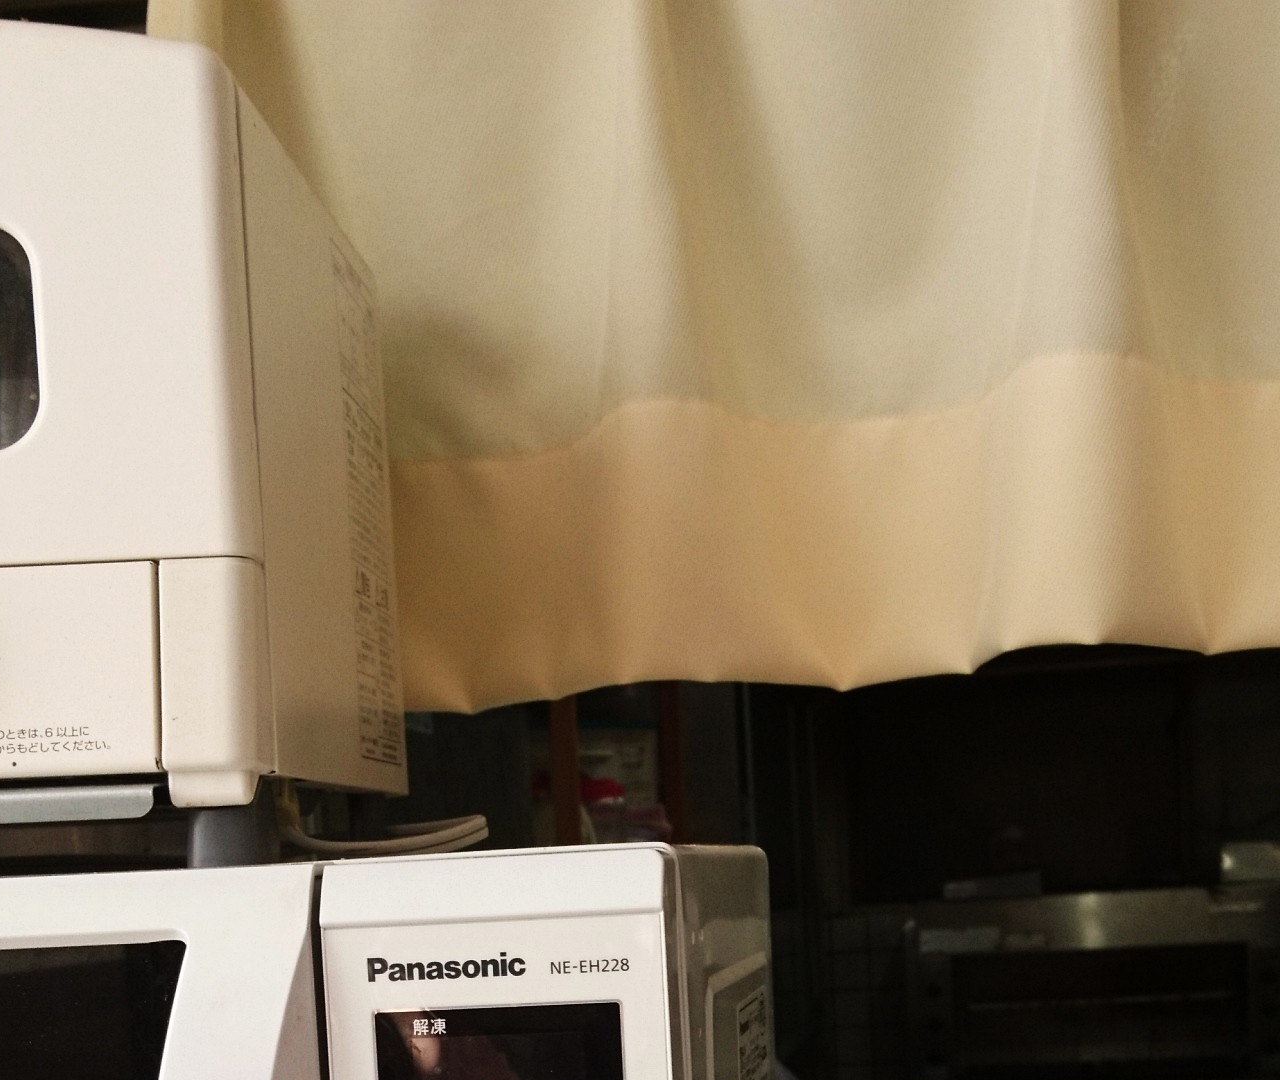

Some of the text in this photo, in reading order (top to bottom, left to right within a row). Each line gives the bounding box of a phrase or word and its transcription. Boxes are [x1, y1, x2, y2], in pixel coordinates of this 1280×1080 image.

[366, 952, 630, 982] Panasonic NE-EH228
[411, 1016, 449, 1037] 解凍
